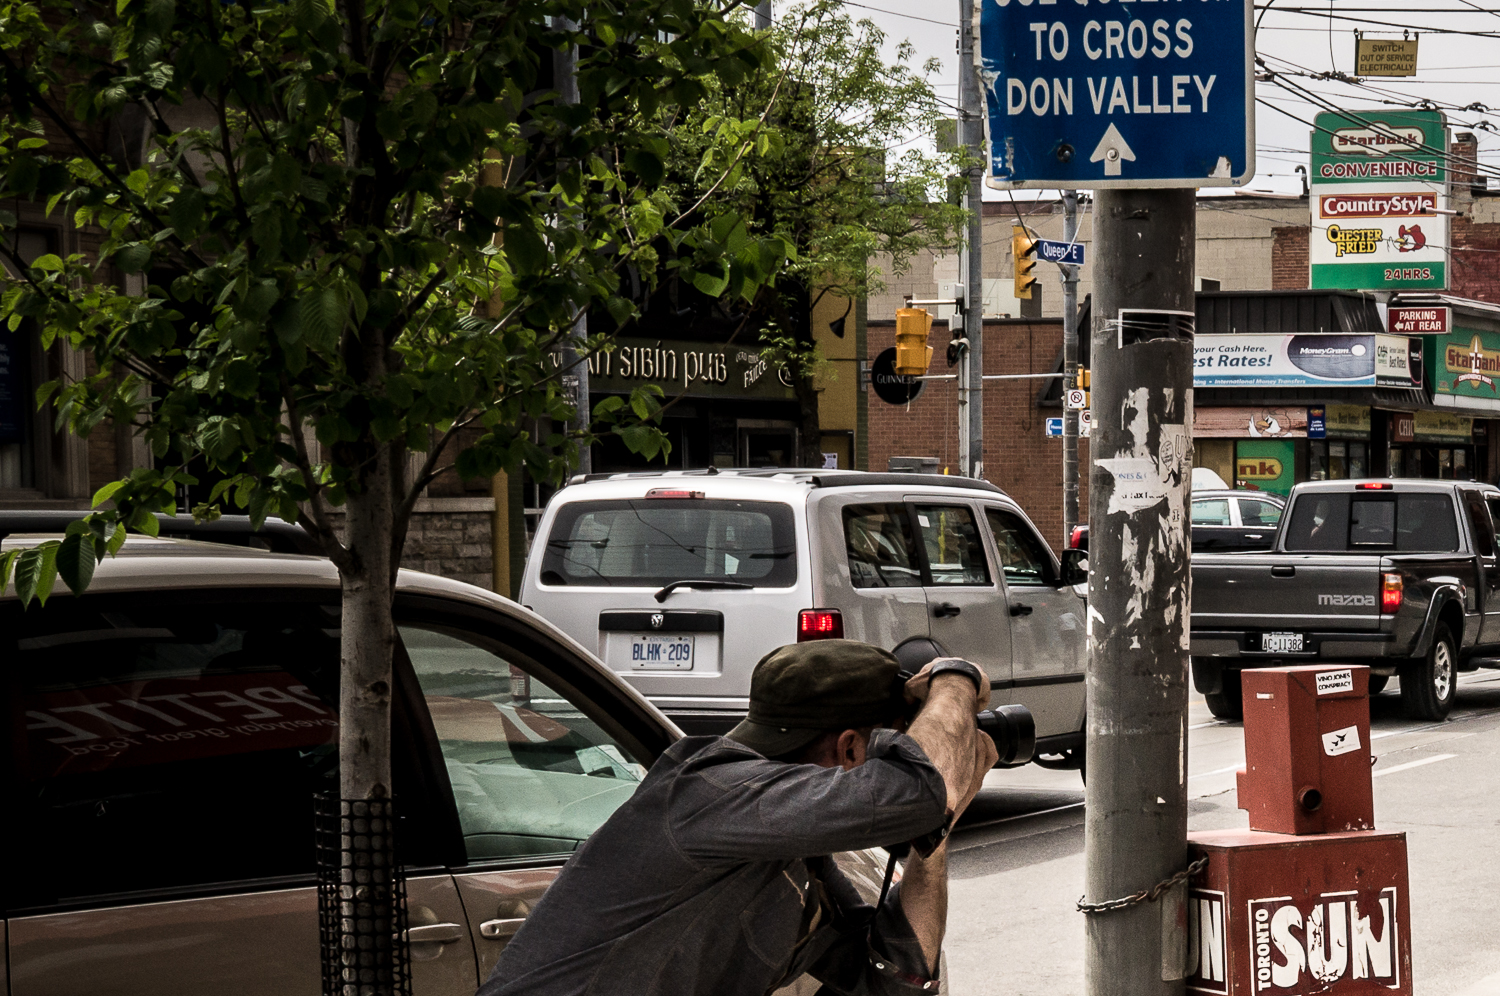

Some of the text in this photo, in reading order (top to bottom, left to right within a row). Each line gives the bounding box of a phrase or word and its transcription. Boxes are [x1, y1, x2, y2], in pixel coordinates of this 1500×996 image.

[1029, 18, 1194, 61] TO CROSS
[1372, 44, 1404, 53] SWITCH
[1360, 53, 1415, 62] OUT OF SERVICE
[1360, 63, 1414, 72] ELECTRICALLY
[1006, 74, 1217, 116] DON VALLEY
[1337, 133, 1418, 147] Starbank
[1321, 161, 1437, 177] CONVENIENCE
[1323, 196, 1433, 216] CountryStyle
[1327, 224, 1383, 243] CHESTER
[1043, 242, 1066, 258] Queen
[1073, 245, 1078, 260] E
[1335, 240, 1377, 257] FRIED
[1399, 310, 1437, 321] PARKING
[1404, 321, 1442, 331] AT REAR
[1194, 345, 1267, 355] your Cash Here.
[1299, 347, 1349, 355] MoneyGram
[1193, 354, 1273, 368] est Rates!
[1318, 594, 1376, 607] mazda
[1262, 637, 1303, 651] AC 11382
[632, 643, 690, 661] BLHK 209
[1333, 672, 1351, 682] JONES
[1318, 681, 1351, 691] CONSPIRACY
[1255, 908, 1272, 992] TORONTO
[1270, 897, 1393, 988] SUN
